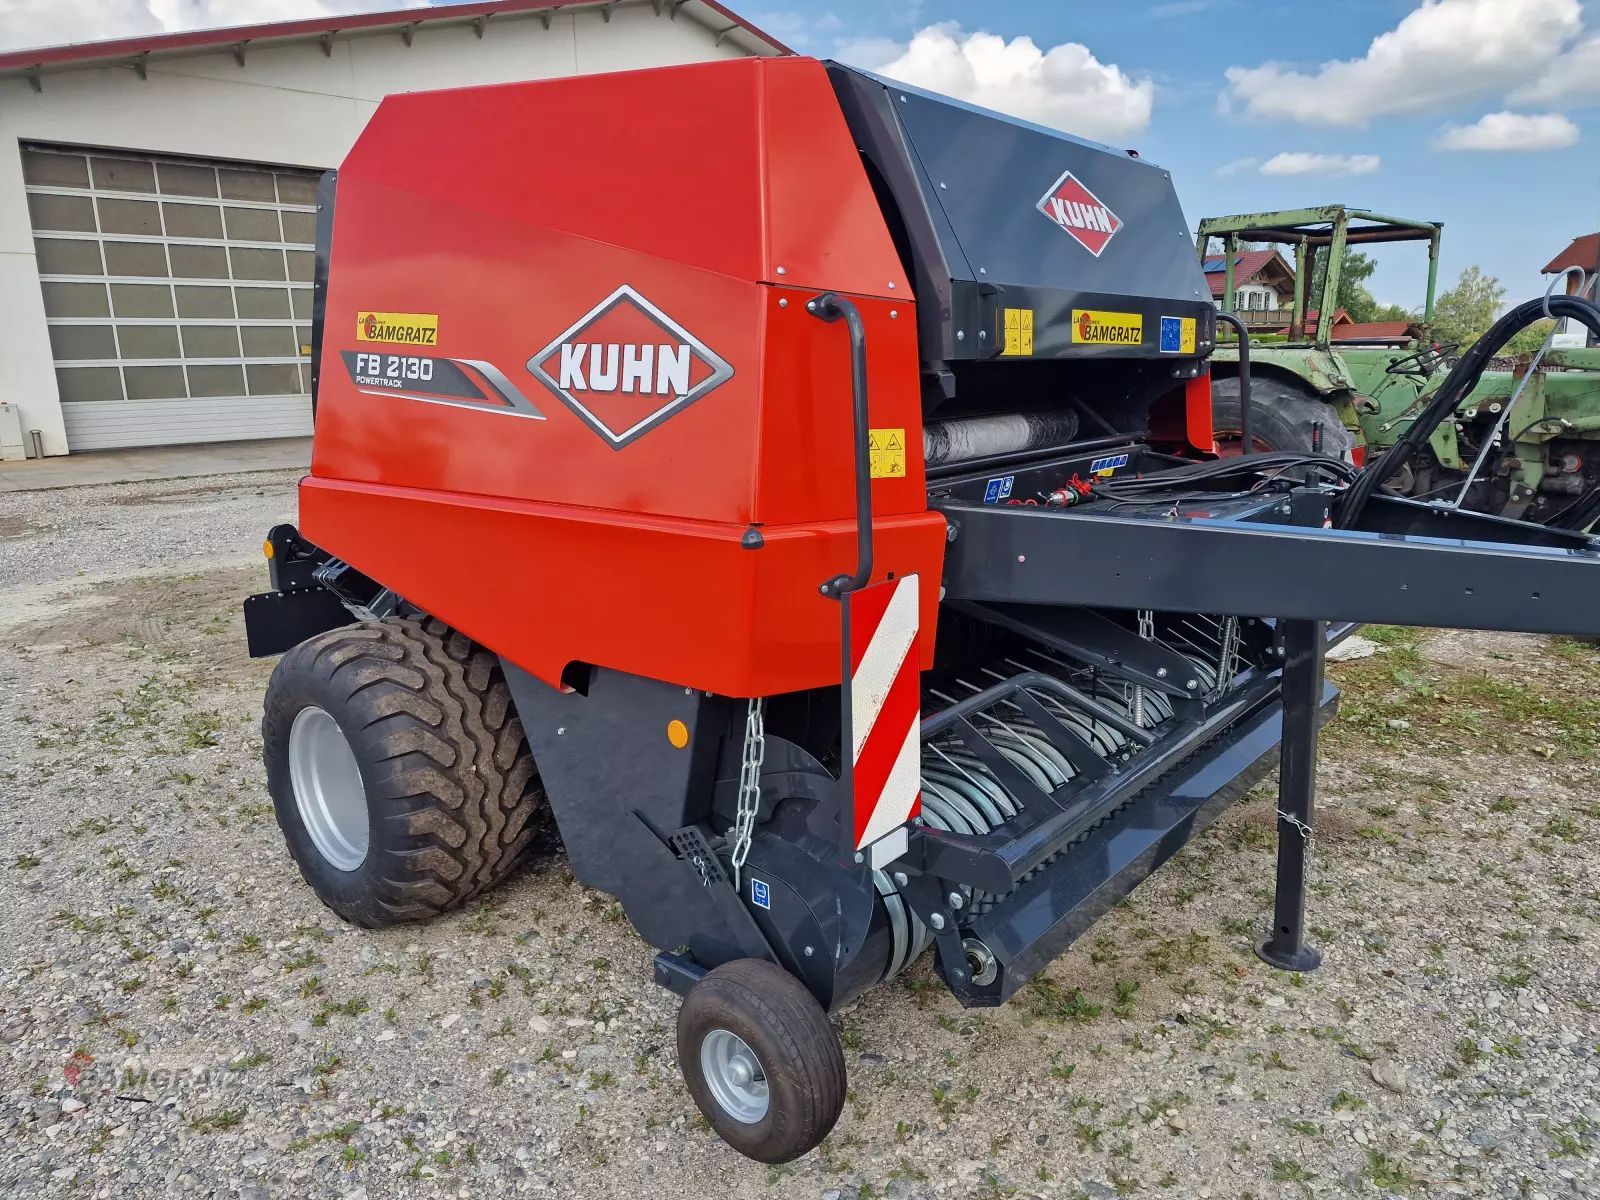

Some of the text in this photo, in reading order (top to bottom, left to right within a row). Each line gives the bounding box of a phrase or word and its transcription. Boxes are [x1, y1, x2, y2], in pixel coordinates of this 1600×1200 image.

[1050, 196, 1113, 234] KUHN
[368, 325, 436, 343] BAMGRATZ
[1084, 324, 1140, 342] BAMGRATZ
[356, 353, 433, 381] FB 2130
[559, 343, 691, 396] KUHN
[356, 375, 403, 388] POWERTRACK
